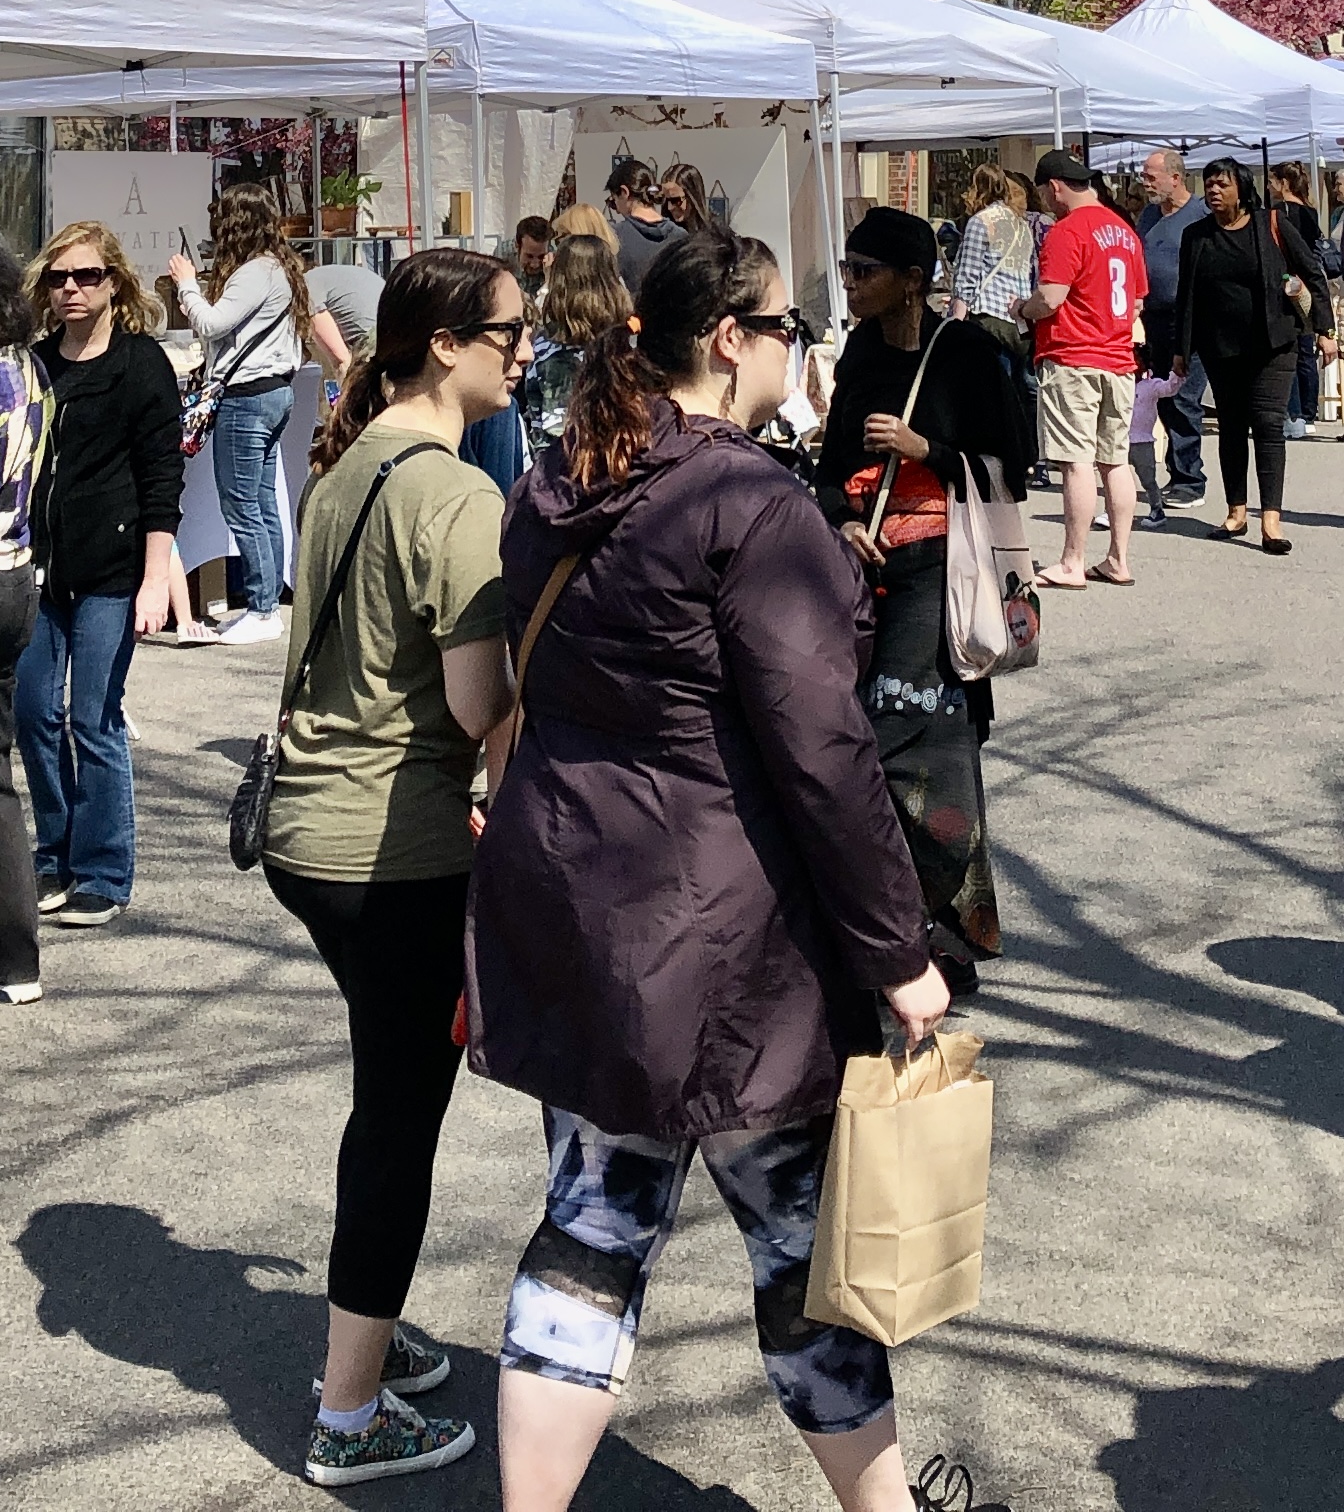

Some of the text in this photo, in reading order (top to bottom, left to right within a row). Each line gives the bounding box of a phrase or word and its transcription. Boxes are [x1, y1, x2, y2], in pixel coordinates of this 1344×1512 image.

[123, 176, 147, 215] A
[1092, 224, 1136, 255] HARPER
[1108, 258, 1128, 317] 3
